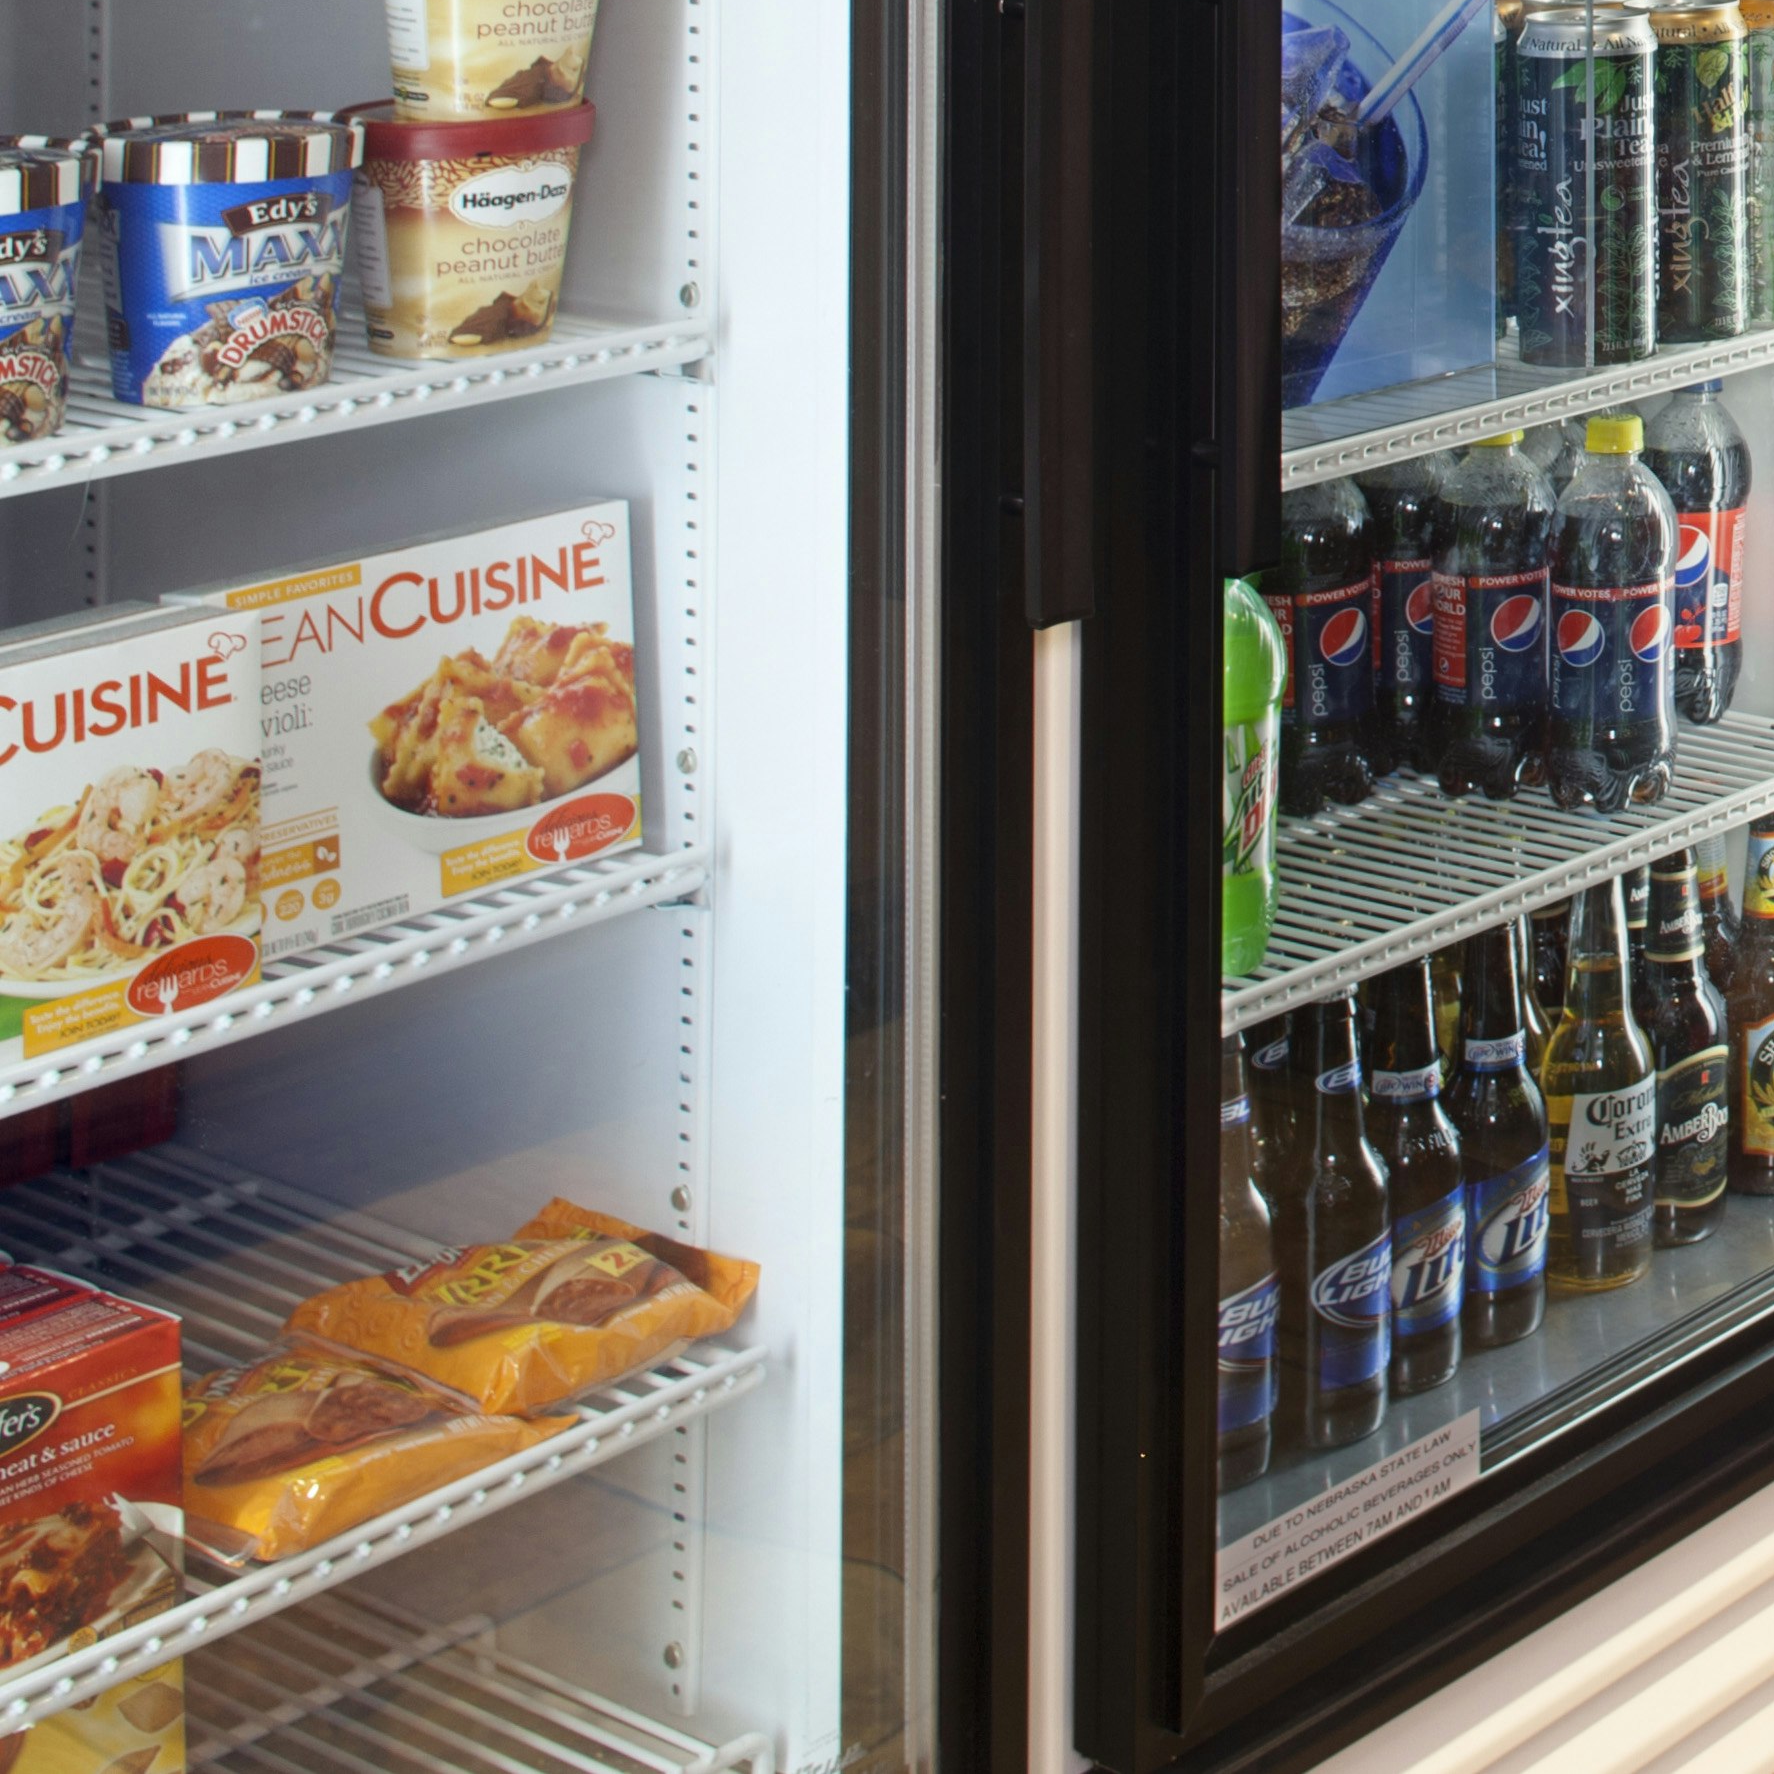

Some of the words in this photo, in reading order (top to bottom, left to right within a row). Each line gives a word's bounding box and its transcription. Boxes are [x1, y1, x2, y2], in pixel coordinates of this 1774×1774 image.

[477, 19, 557, 39] peanut
[1529, 38, 1582, 51] Natural
[248, 193, 319, 226] Edy's
[462, 184, 567, 209] Häagen-Dazs
[461, 227, 561, 255] chocolate
[437, 254, 519, 276] peanut
[217, 307, 328, 368] DRUMSTICK
[234, 590, 282, 608] SIMPLE
[285, 570, 356, 597] FAVORITES
[369, 541, 606, 640] CUISINE
[1306, 590, 1345, 602] POWER
[1479, 575, 1518, 586] POWER
[1578, 589, 1611, 599] VOTES
[1394, 630, 1411, 682] pepsi
[1479, 647, 1497, 699] pepsi
[1308, 664, 1328, 716] pepsi
[1618, 659, 1635, 712] pepsi
[41, 1446, 56, 1463] &
[60, 1424, 116, 1455] sauce
[1253, 1529, 1281, 1549] DUE
[1285, 1513, 1304, 1532] TO
[1307, 1472, 1377, 1518] NEBRASKA
[1380, 1451, 1421, 1478] STATE
[1424, 1430, 1451, 1455] LAW
[1223, 1563, 1258, 1593] SALE
[1262, 1552, 1281, 1571] OF
[1284, 1507, 1360, 1557] ALCOHOLIC
[1363, 1464, 1440, 1512] BEVERAGES
[1443, 1441, 1477, 1466] ONLY
[1221, 1567, 1295, 1621] AVAILABLE
[1300, 1530, 1363, 1576] BETWEEN
[1366, 1511, 1393, 1538] 7AM
[1396, 1493, 1422, 1519] AND
[1425, 1488, 1431, 1499] 1
[1432, 1478, 1451, 1499] AM
